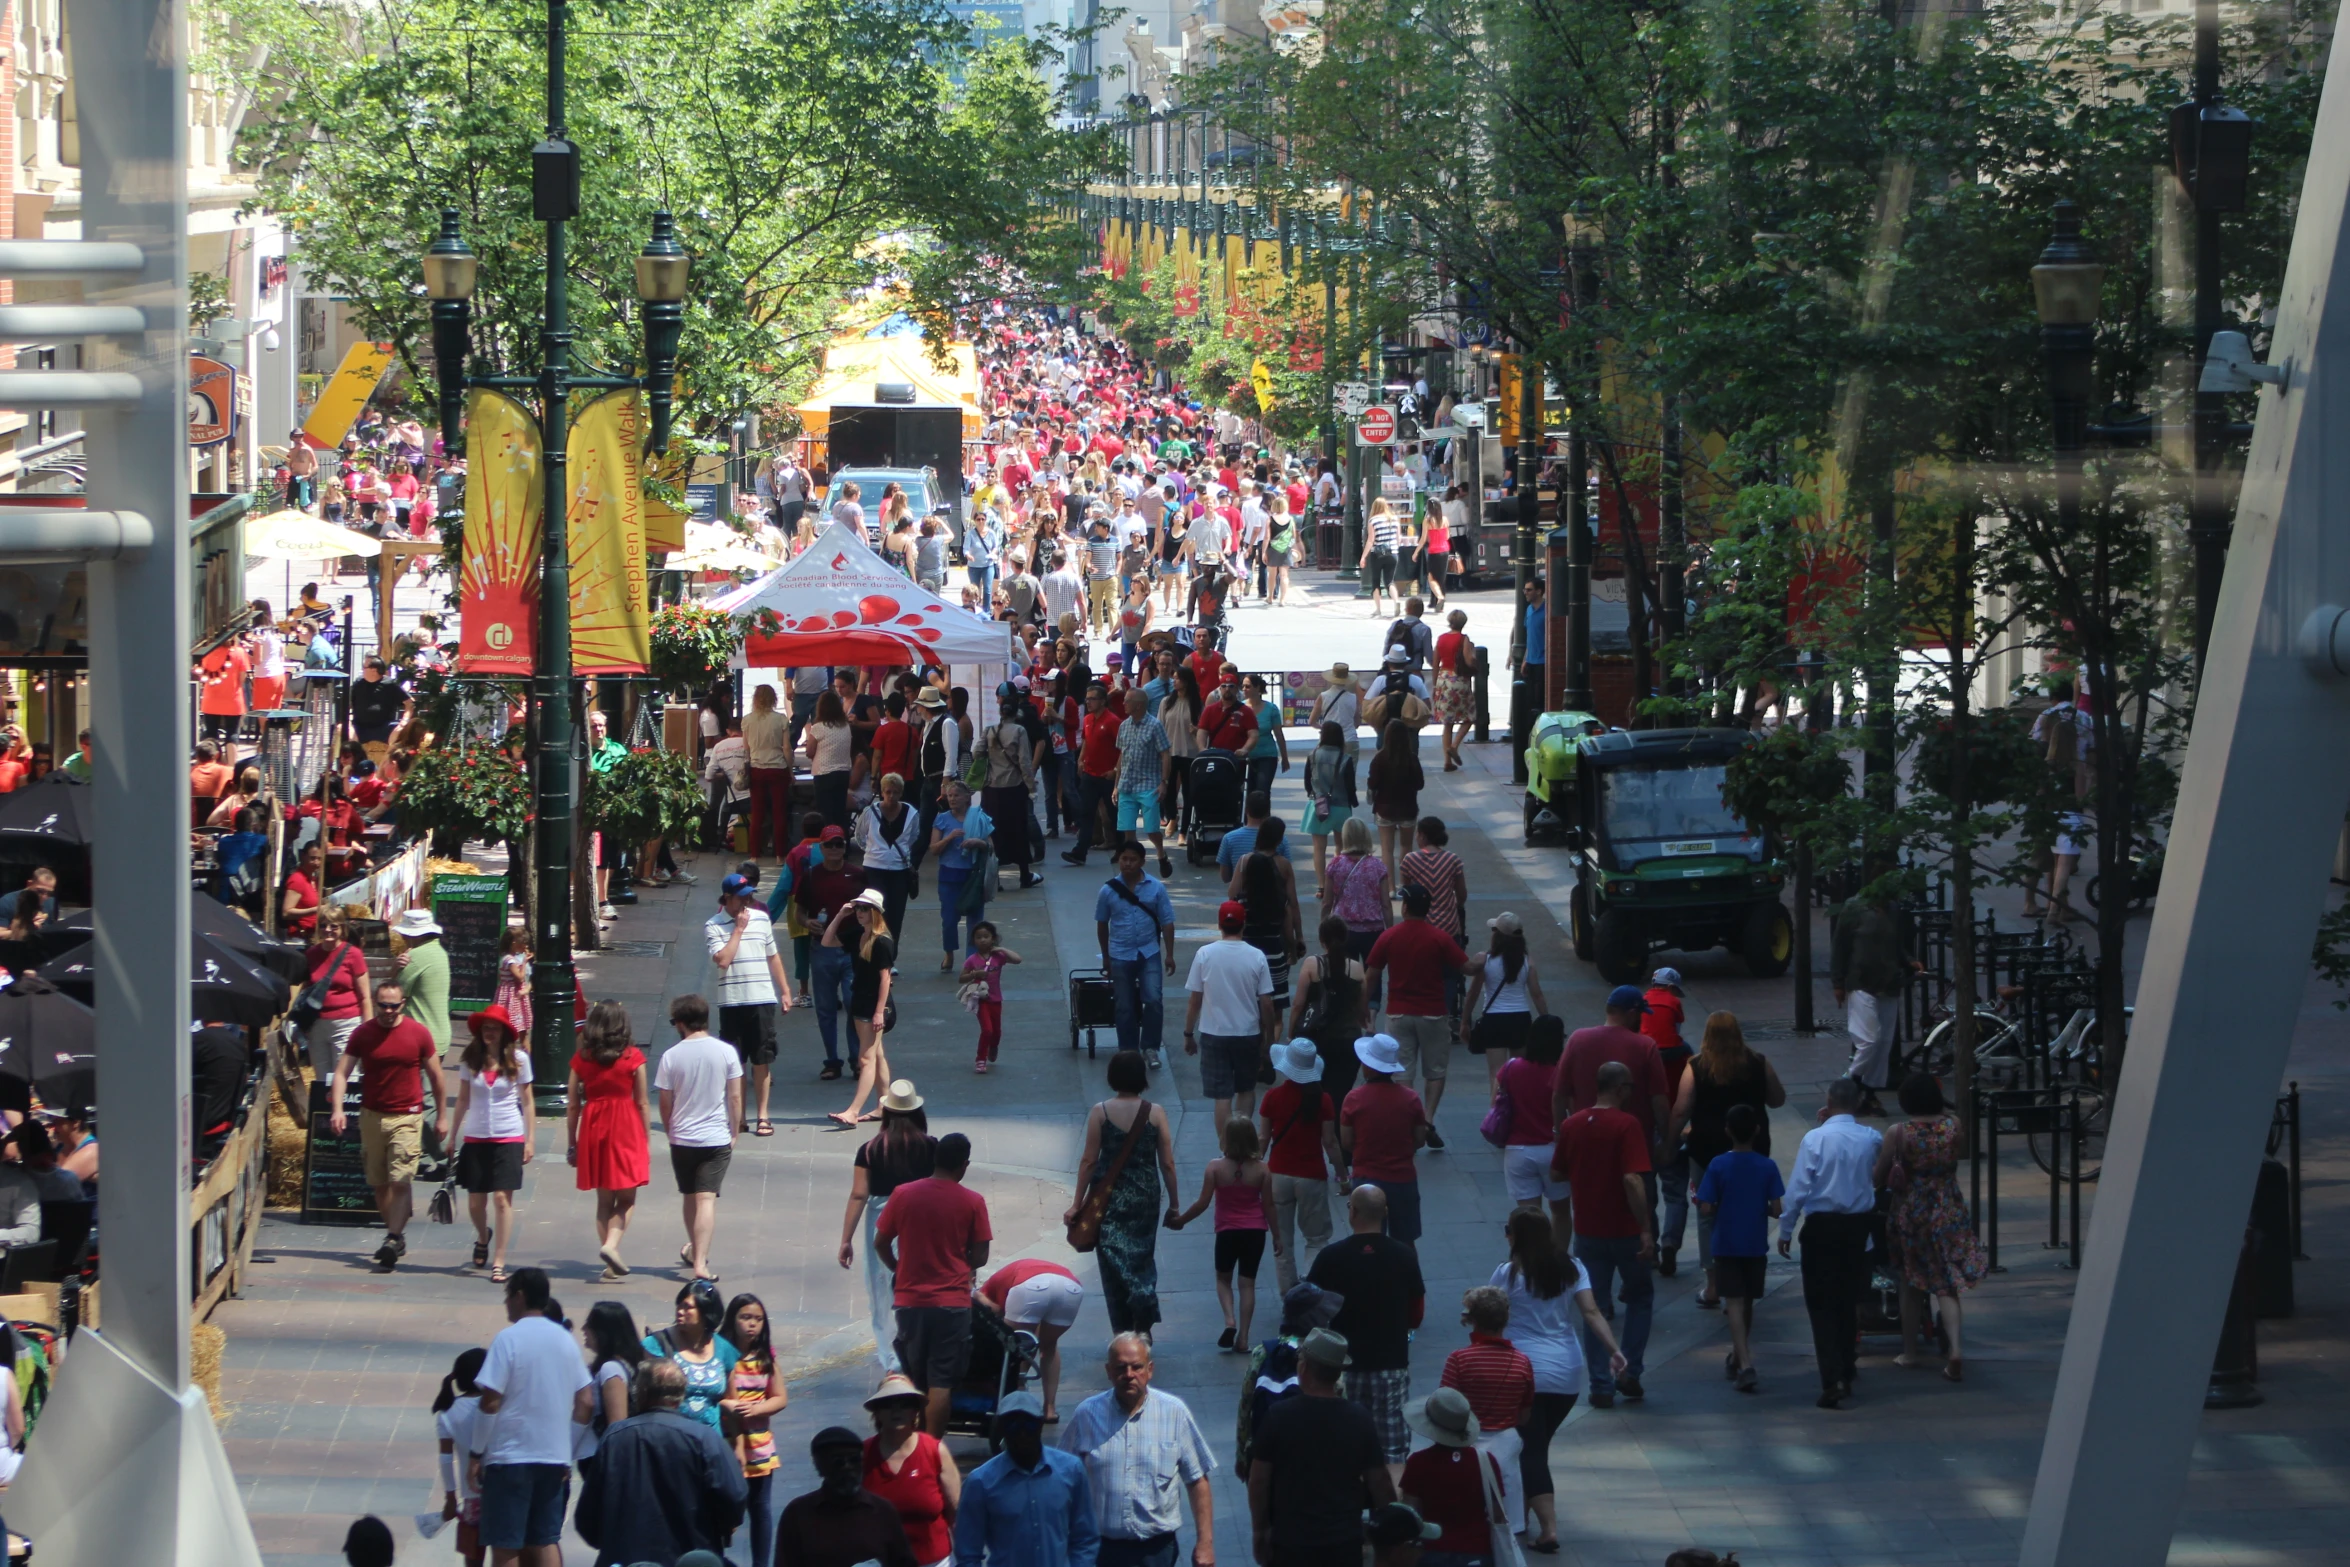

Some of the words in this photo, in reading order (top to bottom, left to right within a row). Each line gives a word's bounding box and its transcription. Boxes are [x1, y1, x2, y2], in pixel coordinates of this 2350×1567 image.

[1375, 414, 1390, 422] NOT
[617, 400, 637, 448] Walk
[621, 451, 639, 526] Avenue
[275, 539, 323, 550] Coors
[622, 532, 645, 614] Stephen
[785, 574, 828, 582] Canadian
[860, 573, 898, 582] Services
[778, 581, 812, 589] Société
[885, 582, 907, 590] sang
[463, 653, 504, 661] downtown
[505, 654, 532, 664] calgary
